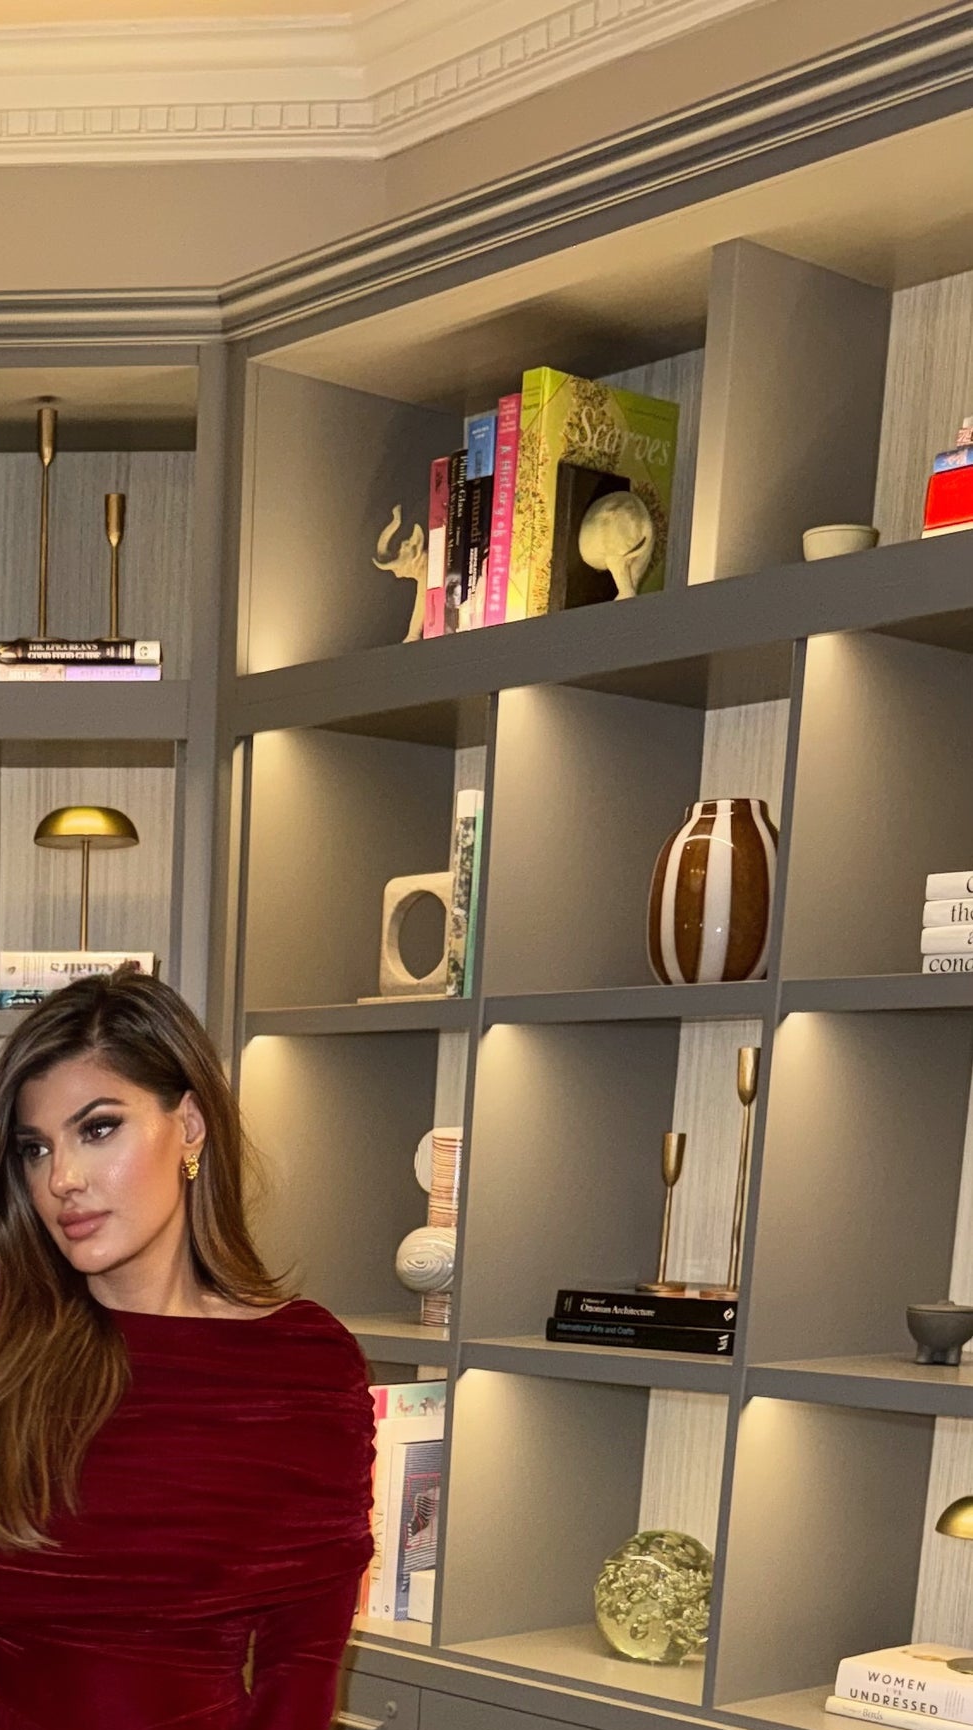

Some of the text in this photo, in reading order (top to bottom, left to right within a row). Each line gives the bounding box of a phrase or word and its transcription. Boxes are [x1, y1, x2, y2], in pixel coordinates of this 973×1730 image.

[500, 445, 512, 454] A
[577, 406, 672, 467] Scarves
[457, 455, 468, 518] Philip Glass
[494, 460, 512, 515] History
[489, 545, 506, 612] pictures
[612, 1306, 656, 1317] Architecture
[850, 1688, 938, 1715] UNDRESSED
[868, 1671, 927, 1692] WOMEN
